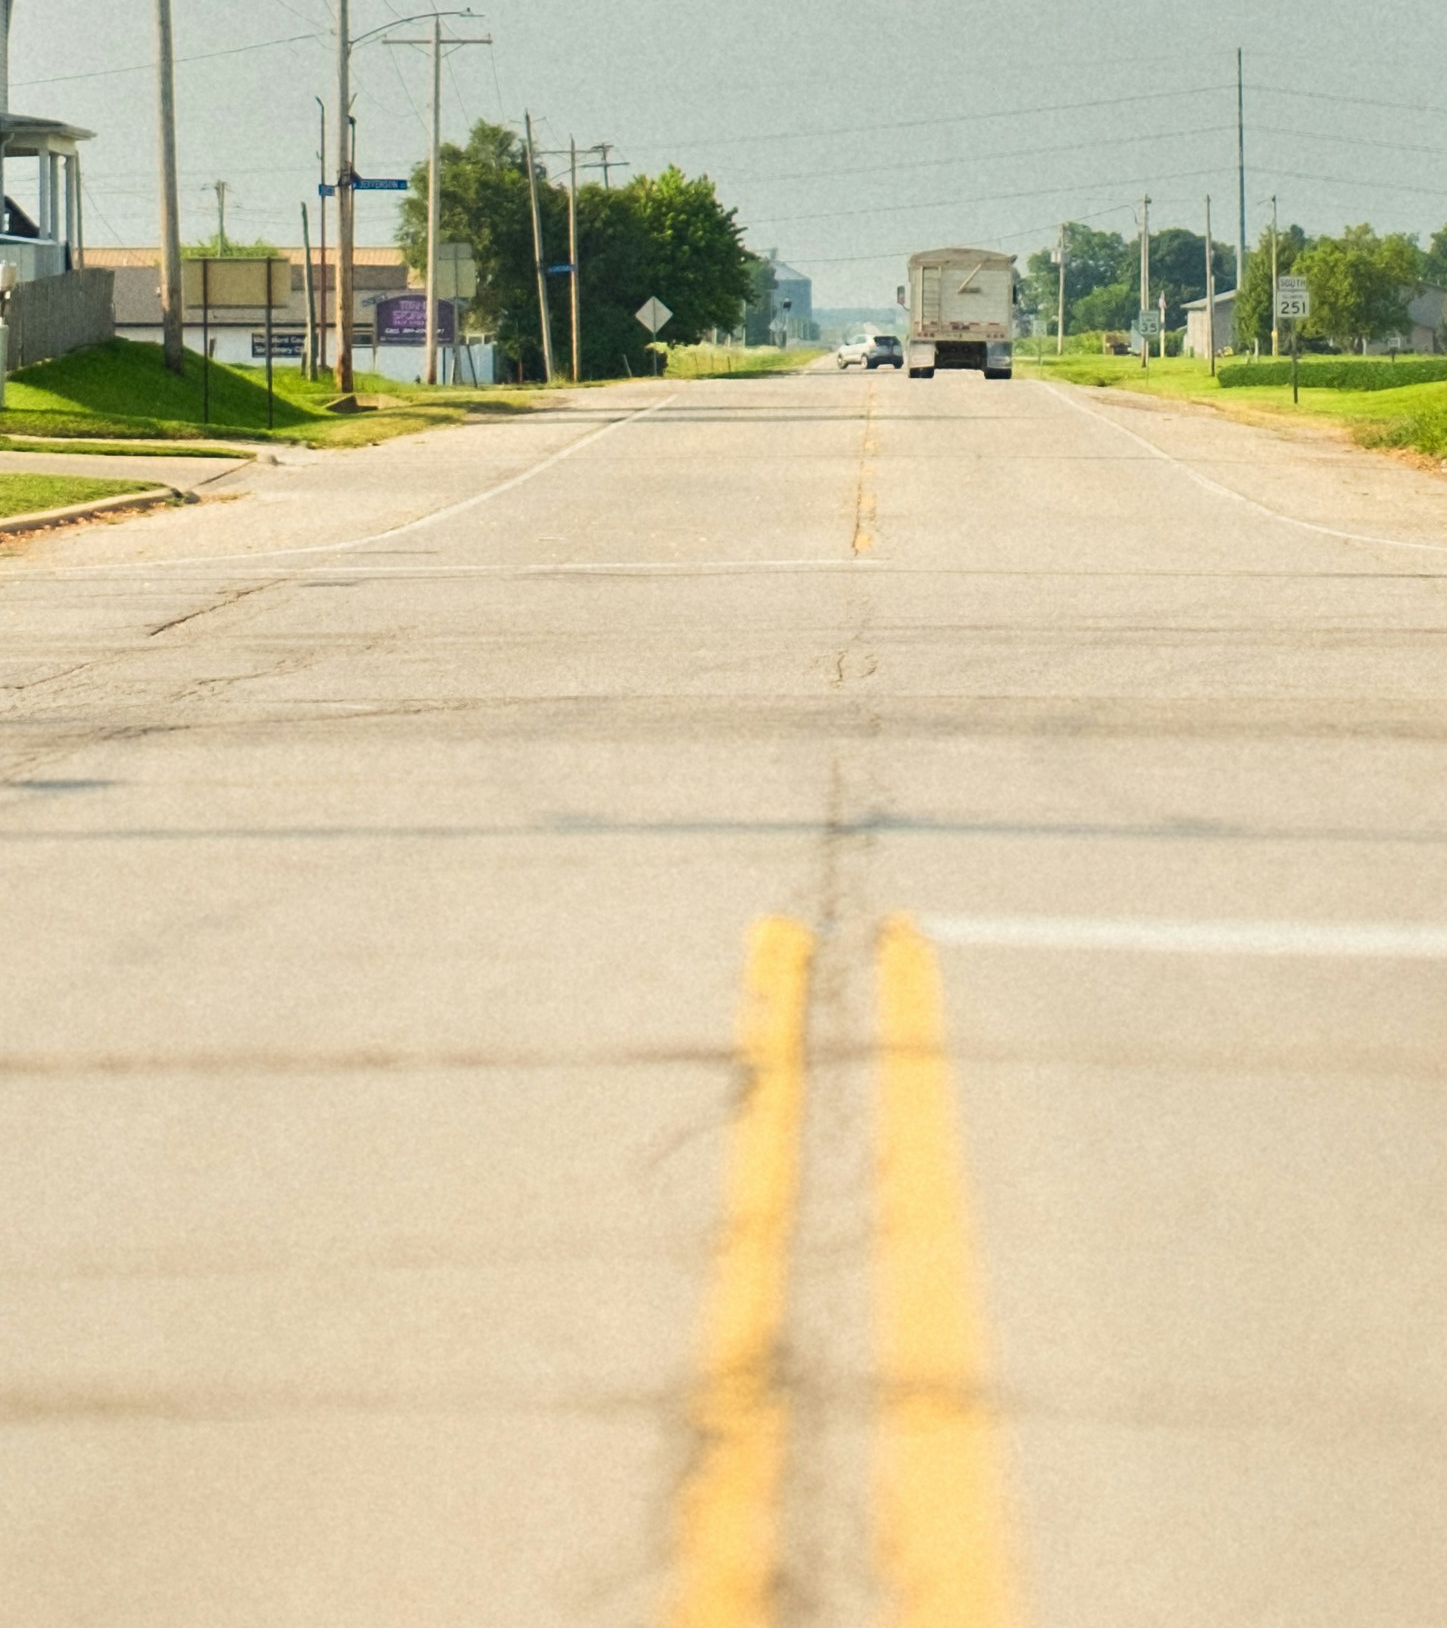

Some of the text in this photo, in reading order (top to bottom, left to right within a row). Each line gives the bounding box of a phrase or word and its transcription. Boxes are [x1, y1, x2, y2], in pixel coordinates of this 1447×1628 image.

[1281, 279, 1305, 287] SOUTH
[1281, 302, 1305, 314] 251
[1141, 323, 1157, 332] 35
